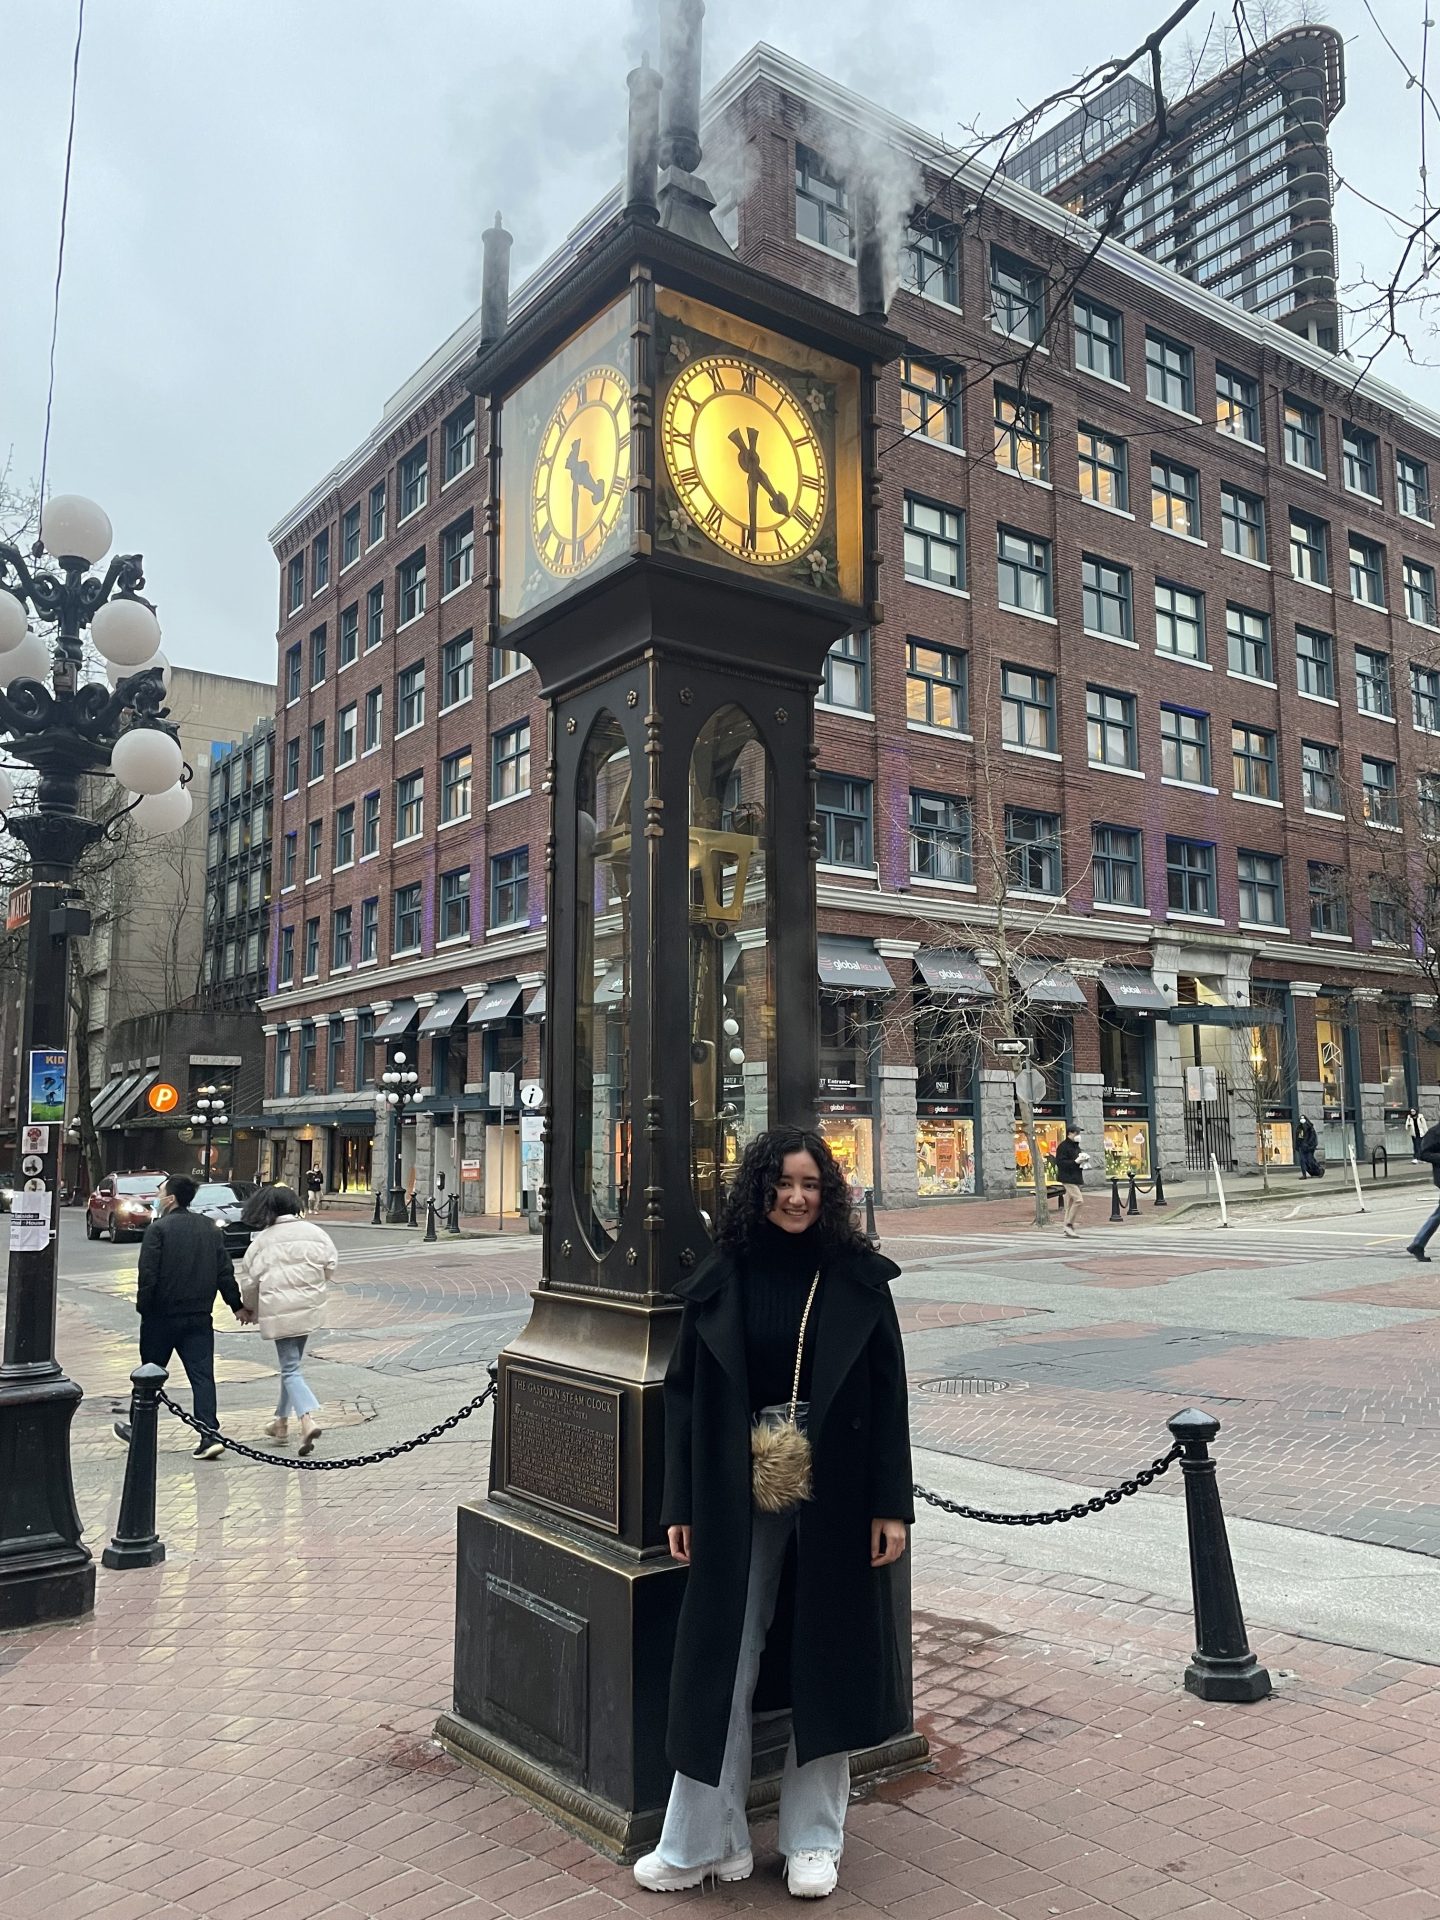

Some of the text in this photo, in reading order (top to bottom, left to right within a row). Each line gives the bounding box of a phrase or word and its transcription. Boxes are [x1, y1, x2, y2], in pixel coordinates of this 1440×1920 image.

[833, 959, 860, 971] global
[155, 1088, 172, 1108] P
[514, 1379, 526, 1391] THE
[527, 1382, 560, 1400] GASTOWN
[562, 1391, 584, 1407] STEAM
[586, 1396, 612, 1414] CLOCK
